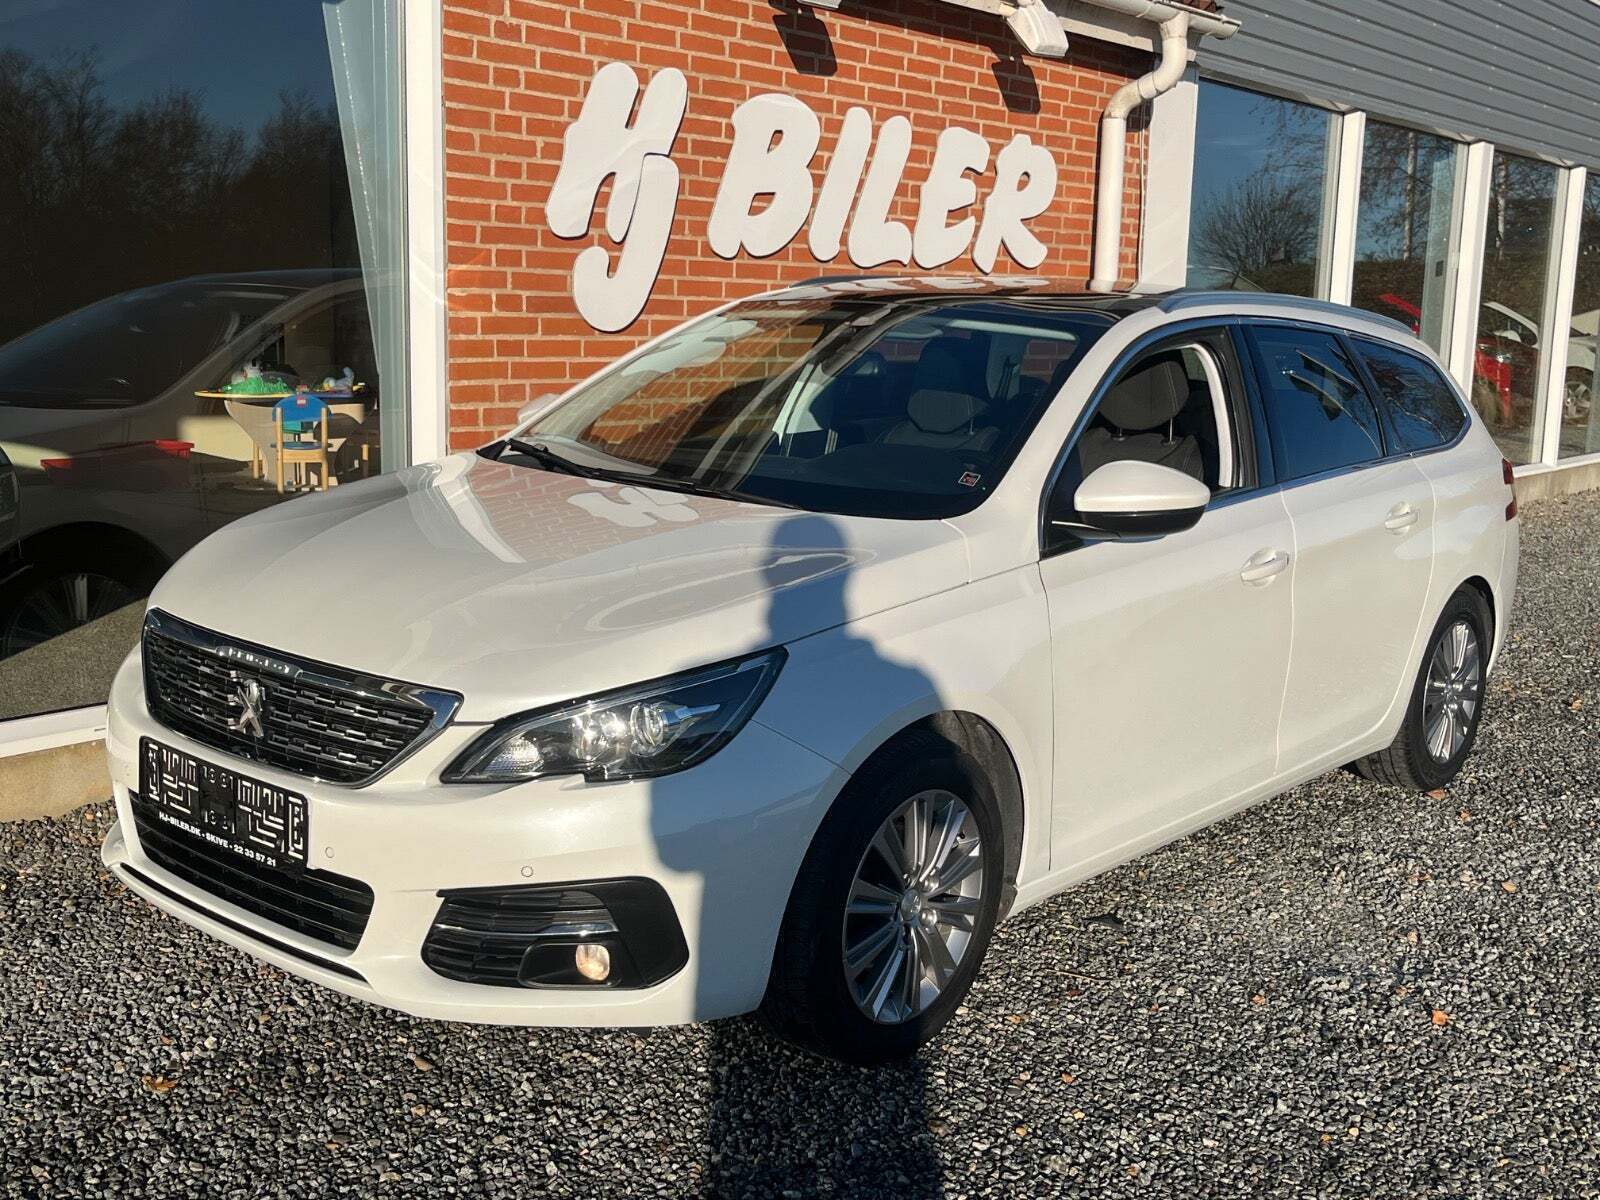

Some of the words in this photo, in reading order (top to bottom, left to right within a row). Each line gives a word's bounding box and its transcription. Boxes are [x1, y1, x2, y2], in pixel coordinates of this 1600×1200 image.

[707, 93, 1058, 274] BILER
[159, 811, 201, 836] HJ-BILER.DK
[206, 833, 228, 848] SKIVE
[234, 844, 244, 855] 22
[245, 848, 254, 859] 33
[267, 857, 276, 867] 21
